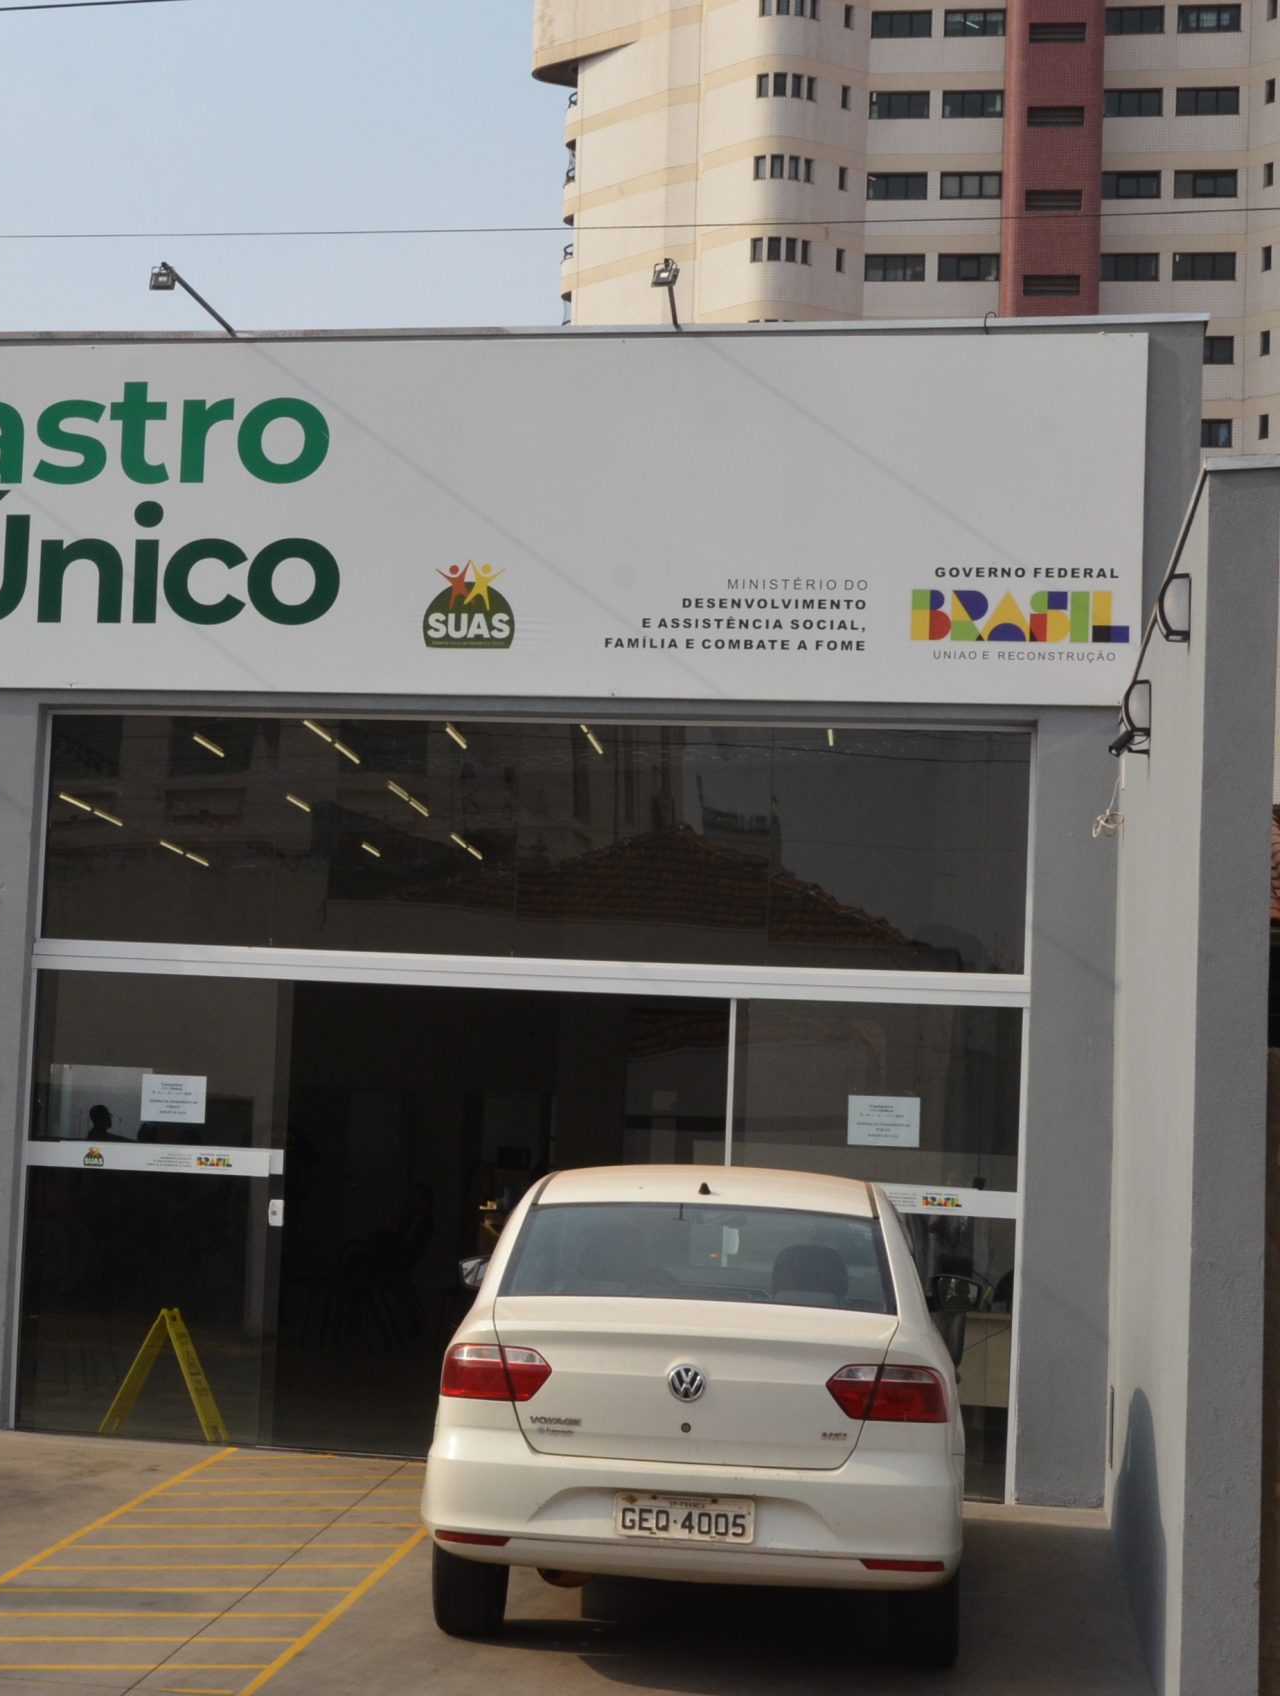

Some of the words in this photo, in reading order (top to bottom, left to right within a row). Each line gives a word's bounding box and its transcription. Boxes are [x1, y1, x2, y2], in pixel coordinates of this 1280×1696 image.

[934, 566, 1026, 578] GOVERNO
[1033, 567, 1119, 579] FEDERAL
[727, 576, 837, 591] MINISTÉRIO
[844, 579, 868, 591] DO
[682, 597, 866, 610] DESENVOLVIMENTO
[641, 617, 651, 629] E
[657, 615, 783, 630] ASSISTÊNCIA
[790, 618, 866, 633] SOCIAL,
[910, 589, 1130, 643] BRASIL
[426, 612, 511, 639] SUAS
[604, 635, 679, 649] FAMÍLIA
[685, 638, 695, 650] E
[701, 638, 790, 651] COMBATE
[796, 639, 808, 651] A
[815, 639, 866, 652] FOME
[982, 650, 990, 661] E
[997, 650, 1117, 664] RECONSTRUÇÃO
